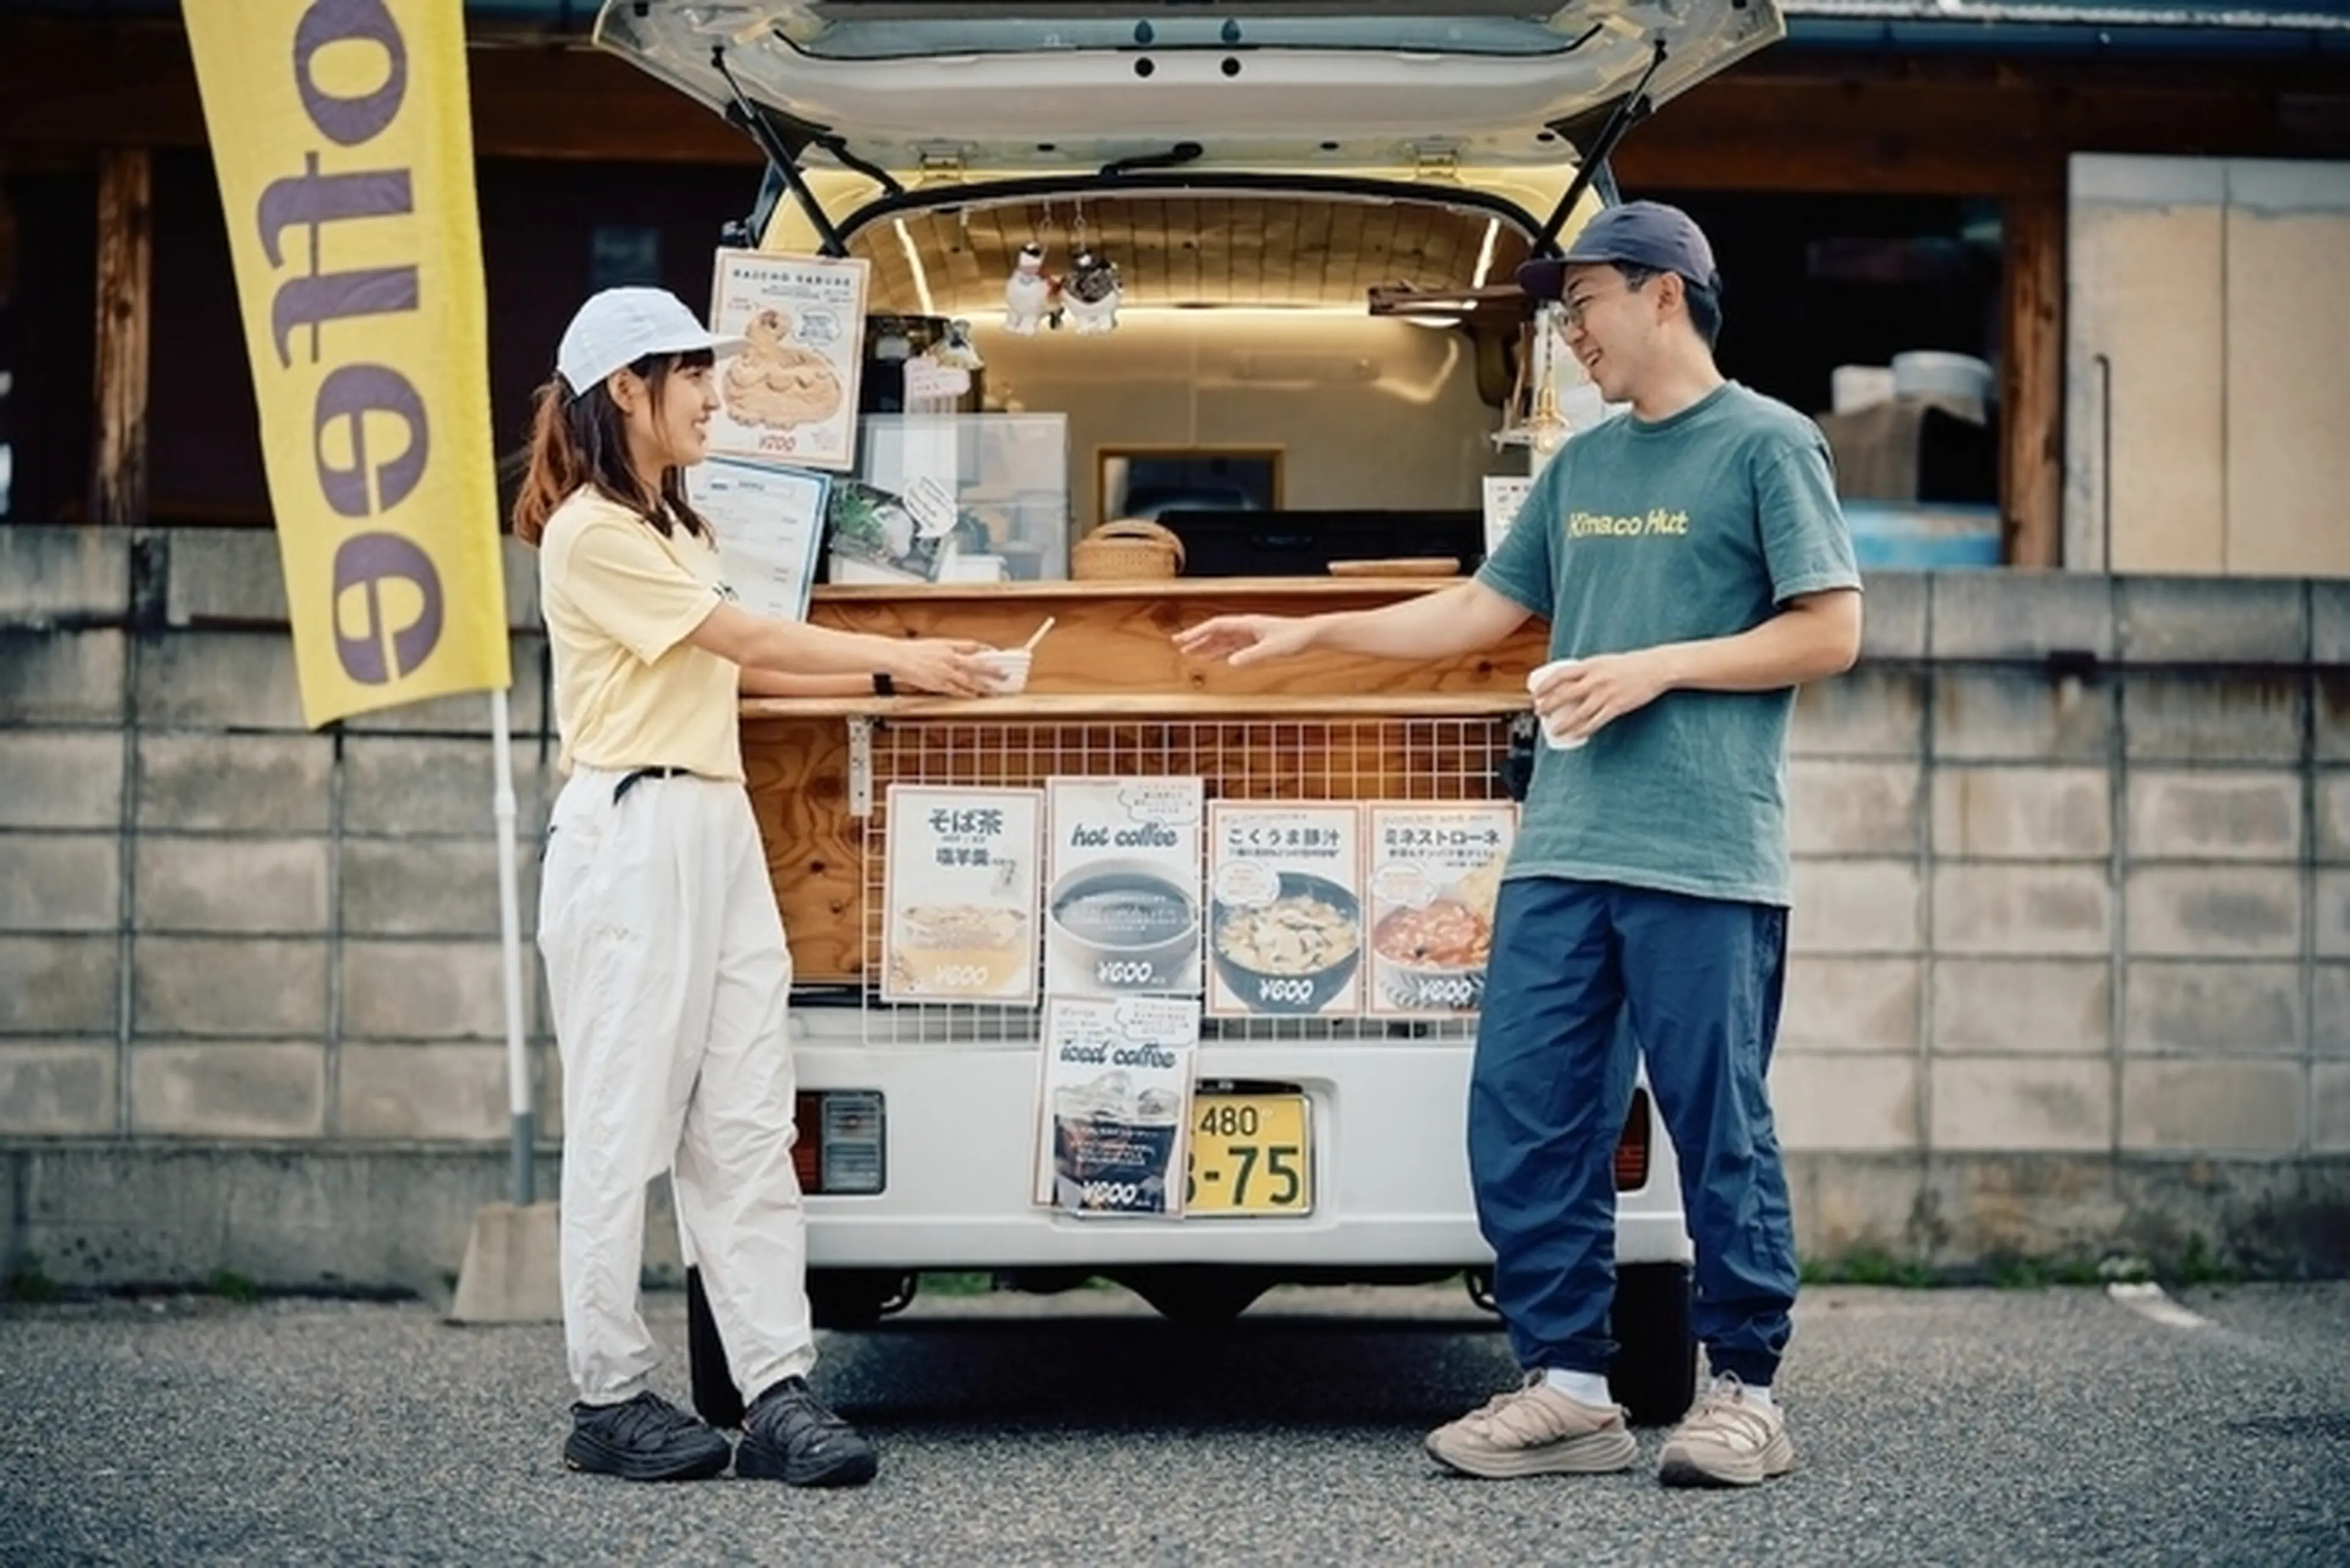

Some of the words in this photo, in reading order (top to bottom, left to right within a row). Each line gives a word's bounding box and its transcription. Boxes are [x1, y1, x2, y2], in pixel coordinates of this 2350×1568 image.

[928, 808, 1003, 835] そば茶
[1071, 823, 1110, 847] hot
[1114, 822, 1177, 847] coffee
[1228, 828, 1340, 846] こくうま豚汁
[1384, 829, 1501, 846] ミネストローネ
[1259, 979, 1314, 1001] ¥600
[1061, 1039, 1109, 1064] iced
[1113, 1043, 1176, 1068] coffee
[1199, 1105, 1258, 1136] 480
